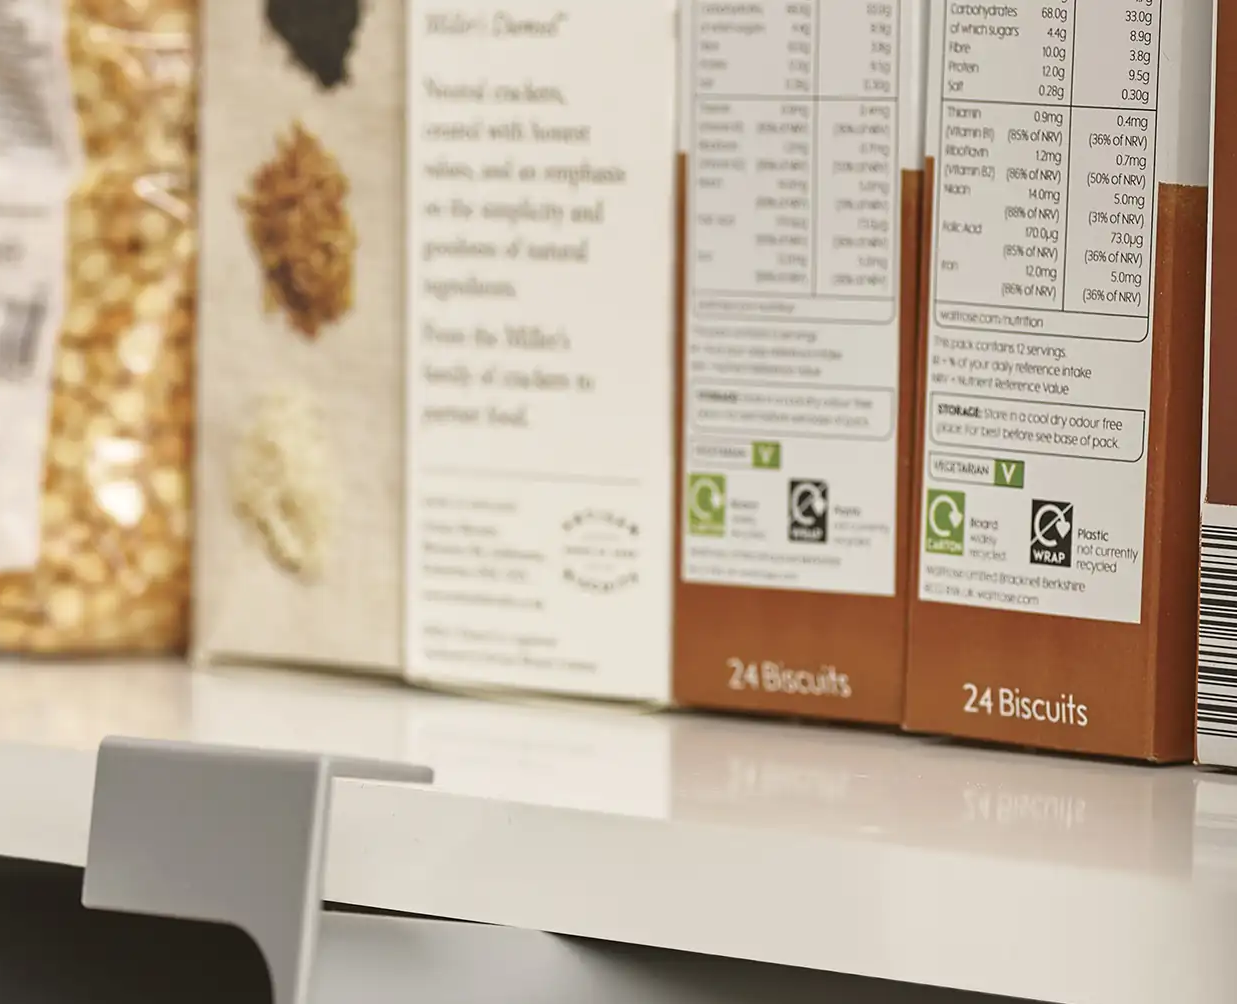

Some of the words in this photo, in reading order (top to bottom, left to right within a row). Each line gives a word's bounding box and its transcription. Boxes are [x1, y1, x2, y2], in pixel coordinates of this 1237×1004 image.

[1041, 7, 1068, 22] 68.0g
[1125, 10, 1152, 26] 33.0g
[989, 26, 1019, 40] sugars
[1047, 27, 1067, 41] 4.4g
[1130, 30, 1152, 45] 8.9g
[1042, 46, 1066, 61] 10.0g
[1129, 50, 1151, 65] 3.8g
[1042, 66, 1065, 80] 12.0g
[1128, 69, 1150, 84] 9.5g
[1038, 85, 1064, 100] 0.28g
[1121, 89, 1149, 104] 0.30g
[1034, 111, 1063, 127] 0.9mg
[1117, 116, 1148, 131] 0.4mg
[1030, 130, 1040, 142] of
[1041, 130, 1063, 147] NRV)
[1088, 133, 1112, 148] (36%
[1112, 133, 1125, 147] of
[1125, 135, 1148, 150] NRV)
[1036, 150, 1062, 166] 1.2mg
[1116, 155, 1147, 170] 0.7mg
[1029, 168, 1039, 181] of
[1040, 169, 1061, 185] NRV)
[1087, 172, 1110, 187] (50%
[1111, 172, 1123, 186] of
[1123, 174, 1146, 190] NRV)
[1028, 188, 1061, 204] 14.0mg
[1114, 193, 1145, 209] 5.0mg
[1027, 206, 1037, 219] of
[1038, 208, 1060, 224] NRV)
[1088, 211, 1108, 225] (31%
[1109, 211, 1121, 225] of
[1122, 213, 1145, 229] NRV)
[1025, 246, 1036, 258] of
[1037, 247, 1058, 263] NRV)
[1084, 249, 1107, 264] (36%
[1108, 250, 1120, 264] of
[1120, 252, 1143, 268] NRV)
[1025, 265, 1057, 282] 12.0mg
[1110, 271, 1142, 287] 5.0mg
[1024, 284, 1035, 296] of
[1035, 285, 1057, 302] NRV)
[1082, 288, 1106, 303] (36%
[1106, 289, 1118, 303] of
[1119, 291, 1141, 307] NRV)
[1015, 361, 1061, 377] reference
[1062, 365, 1092, 379] intake
[995, 377, 1041, 393] Reference
[1043, 381, 1069, 395] Value
[1019, 412, 1026, 423] a
[1027, 411, 1049, 425] cool
[1050, 413, 1067, 429] dry
[1068, 416, 1100, 429] odour
[1102, 417, 1123, 431] free
[1003, 427, 1034, 442] before
[1036, 431, 1052, 444] see
[1053, 431, 1079, 446] base
[1080, 434, 1091, 446] of
[1001, 462, 1016, 485] V
[1078, 528, 1109, 542] Plastic
[1032, 548, 1066, 564] WRAP
[1077, 544, 1094, 556] not
[1095, 545, 1139, 564] currently
[1076, 560, 1117, 575] recycled
[1042, 576, 1086, 592] Berkshire
[725, 656, 760, 691] 24
[760, 660, 853, 698] Biscuits
[963, 682, 994, 715] 24
[998, 687, 1088, 727] Biscuits
